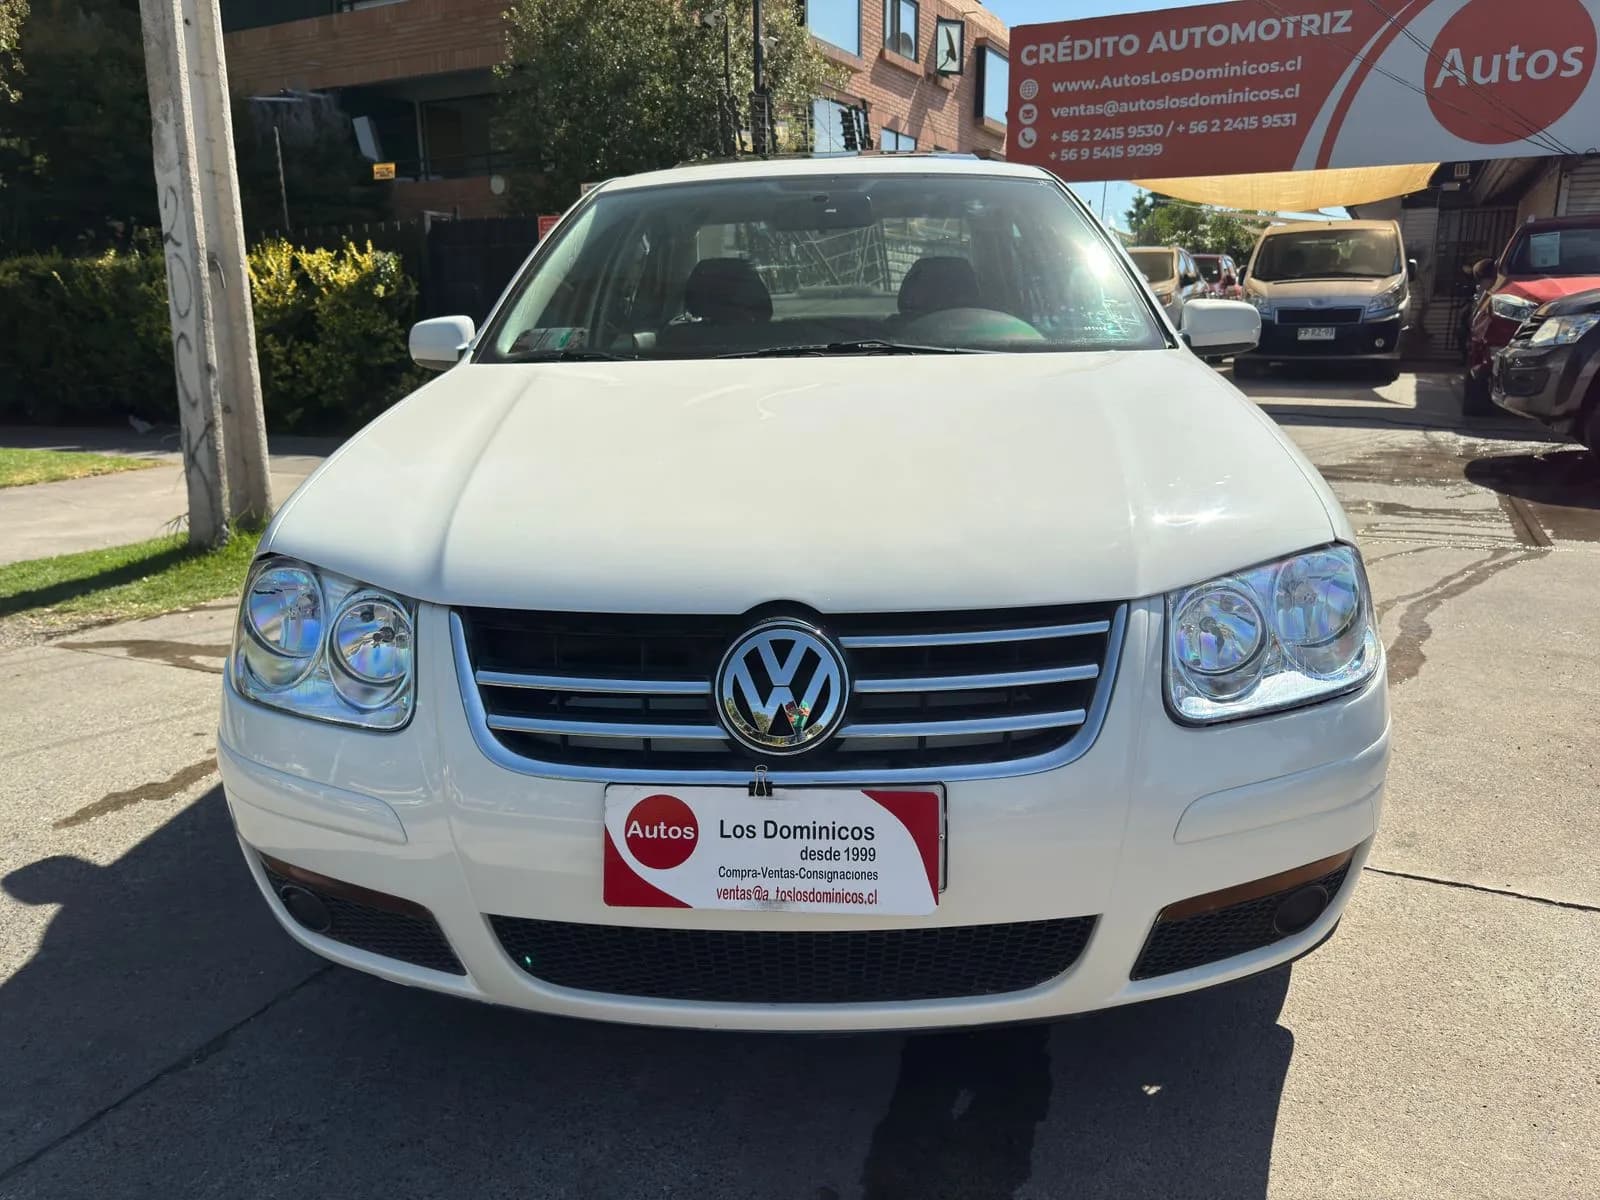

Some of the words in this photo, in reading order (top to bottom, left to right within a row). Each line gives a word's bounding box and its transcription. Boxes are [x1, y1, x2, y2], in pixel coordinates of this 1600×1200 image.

[1020, 34, 1140, 66] CRÉDITO
[1147, 9, 1353, 54] AUTOMOTRIZ
[1052, 56, 1302, 93] www.AutosLosDominicos.cl
[1433, 45, 1585, 88] Autos
[1051, 84, 1301, 119] ventas@autoslosdominicos.cl
[1081, 128, 1090, 141] 2
[1092, 126, 1125, 141] 2415
[1127, 124, 1164, 138] 9530
[1210, 119, 1220, 132] 2
[1223, 116, 1258, 131] 2415
[1261, 113, 1297, 128] 9531
[1080, 148, 1090, 160] 9
[1092, 145, 1124, 159] 5415
[1127, 143, 1163, 157] 9299
[626, 820, 695, 840] Autos
[719, 819, 757, 840] Los
[763, 820, 876, 842] Dominicos
[800, 846, 841, 862] desde
[844, 847, 877, 862] 1999
[718, 865, 879, 882] Compra-Ventas-Consignaciones
[716, 884, 878, 905] ventas@atoslosdominicos.cl
